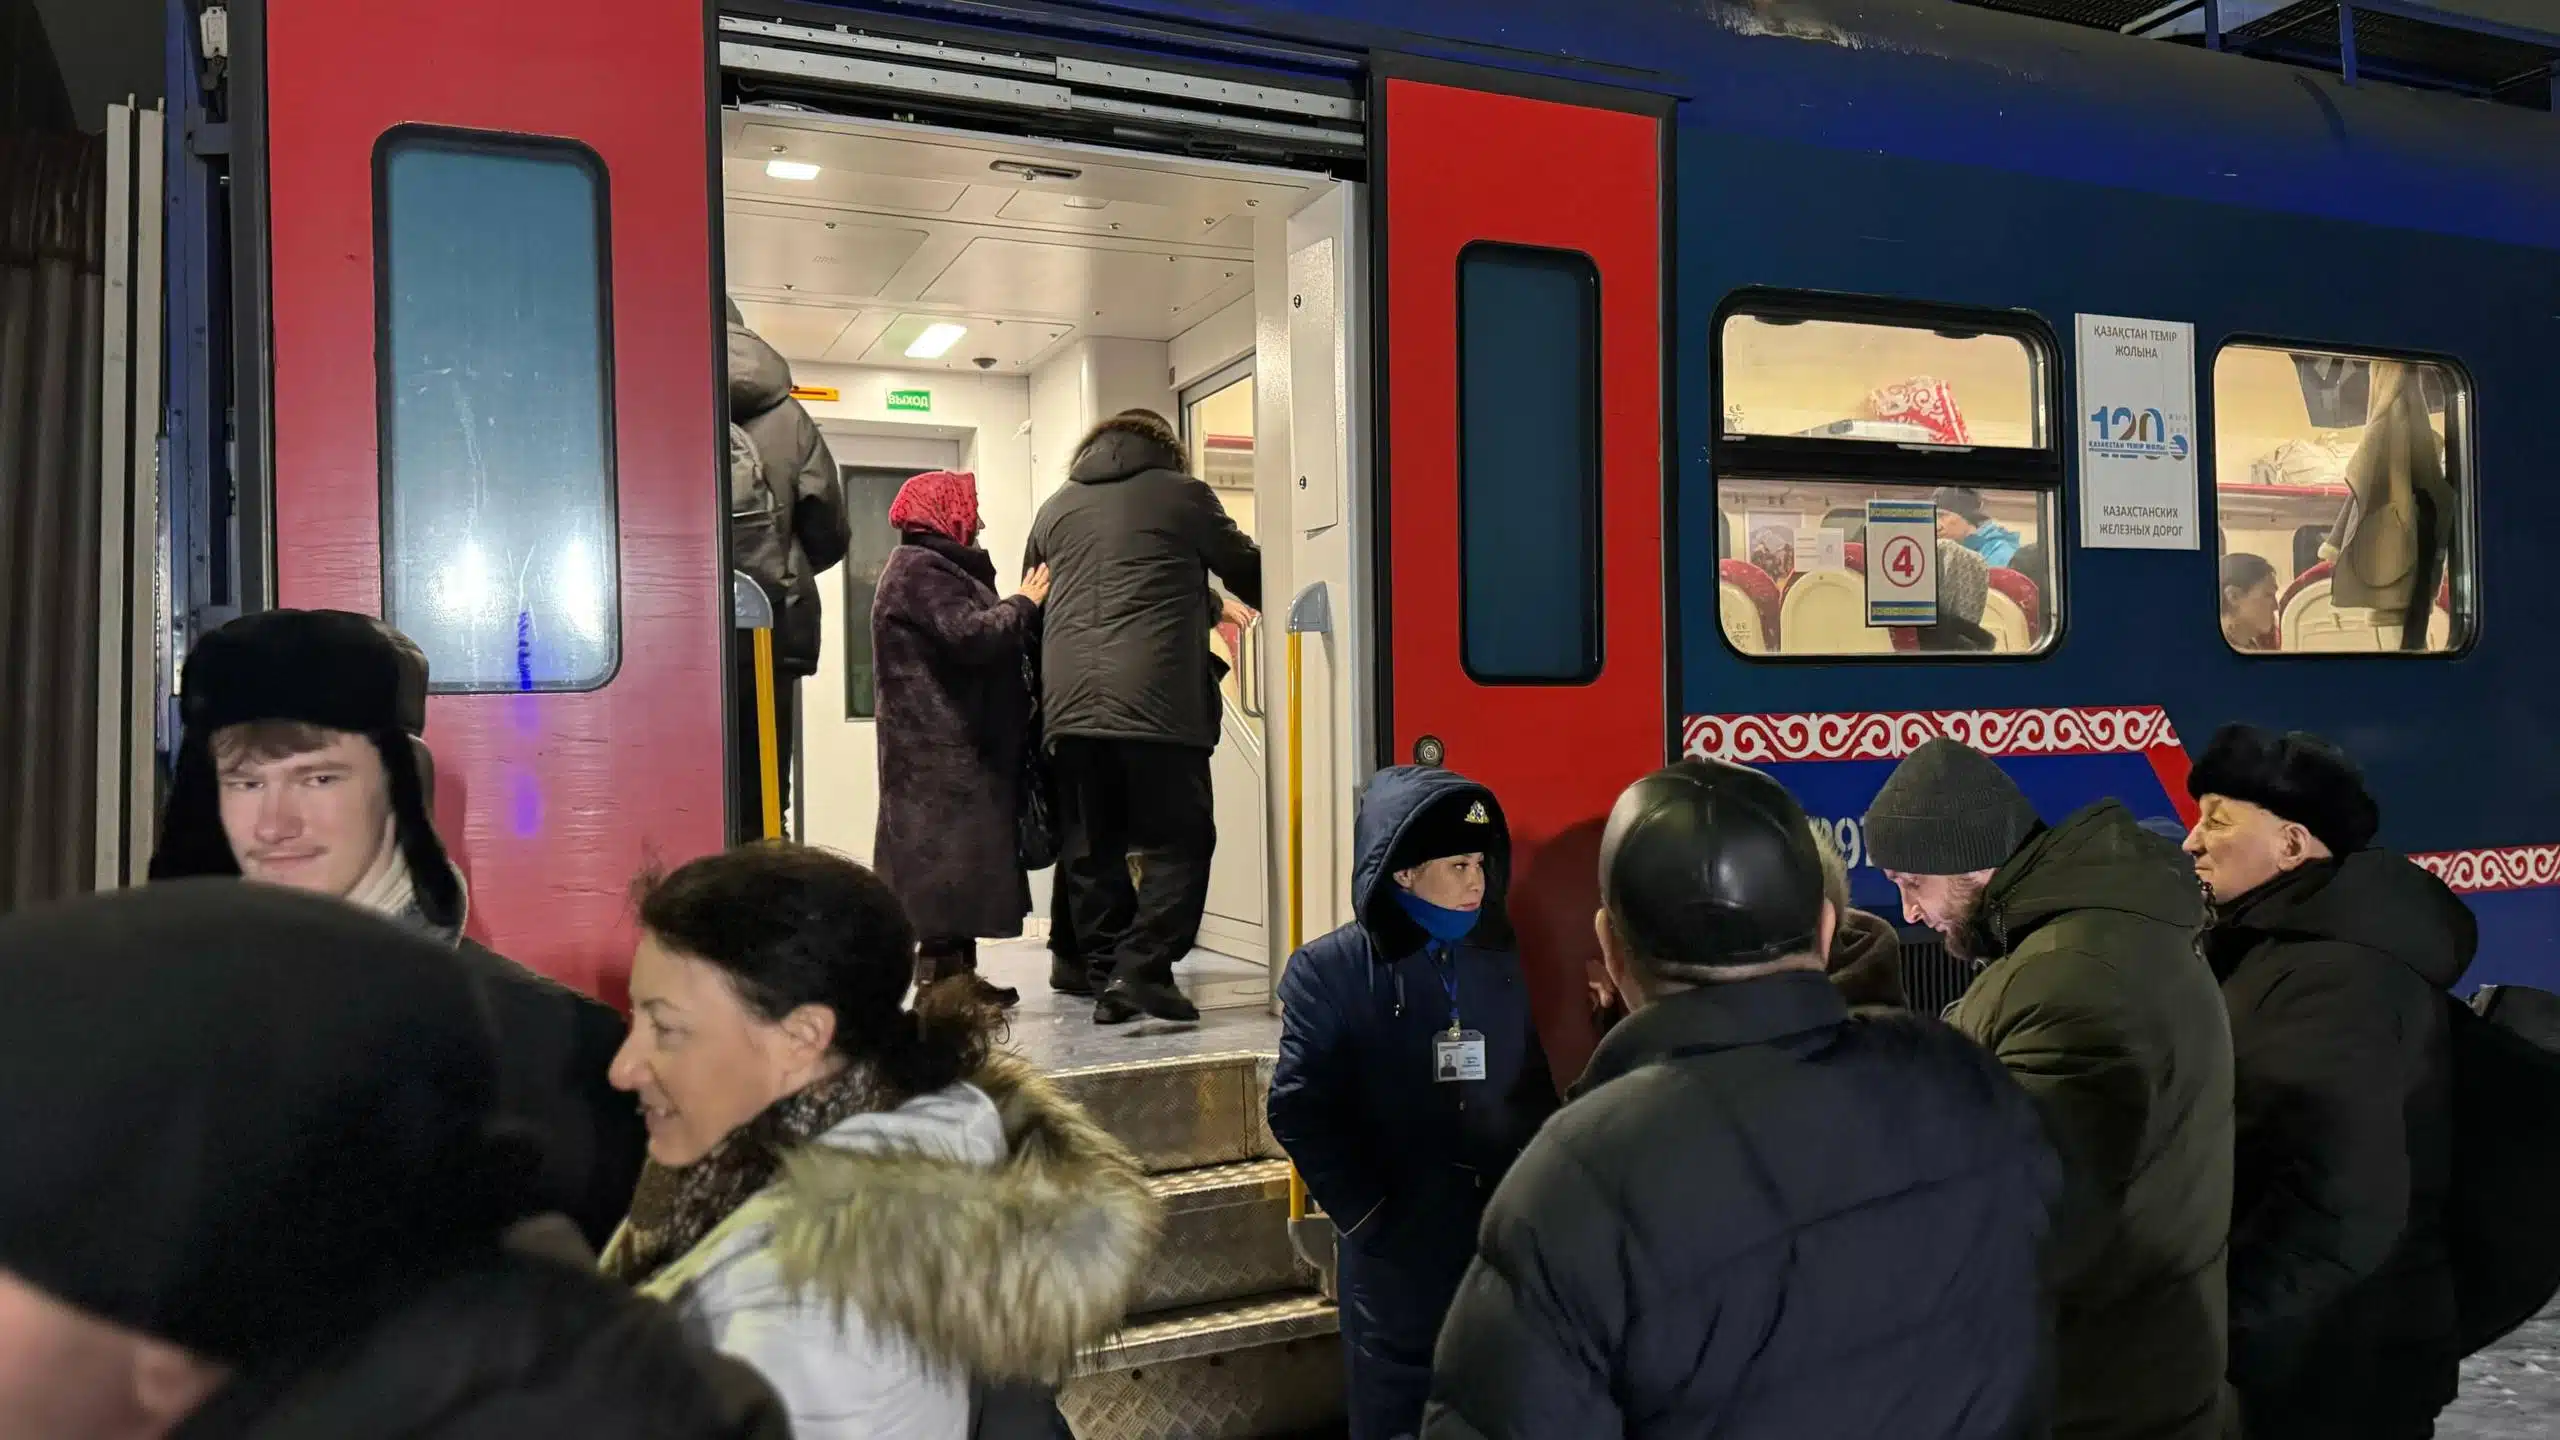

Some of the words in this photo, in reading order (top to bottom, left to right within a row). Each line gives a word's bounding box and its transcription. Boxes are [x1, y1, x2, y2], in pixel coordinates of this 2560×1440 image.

[2094, 325, 2148, 340] ҚАЗАҚСТАН
[2150, 330, 2177, 342] ТЕМІР
[2115, 345, 2159, 359] ЖОЛЫНА
[888, 394, 929, 408] ВЫХОД
[2091, 406, 2165, 443] 120
[2103, 505, 2179, 519] КАЗАХСТАНСКИХ
[2099, 523, 2151, 536] ЖЕЛЕЗНЫХ
[2152, 525, 2184, 538] ДОРОГ
[1892, 545, 1914, 577] 4
